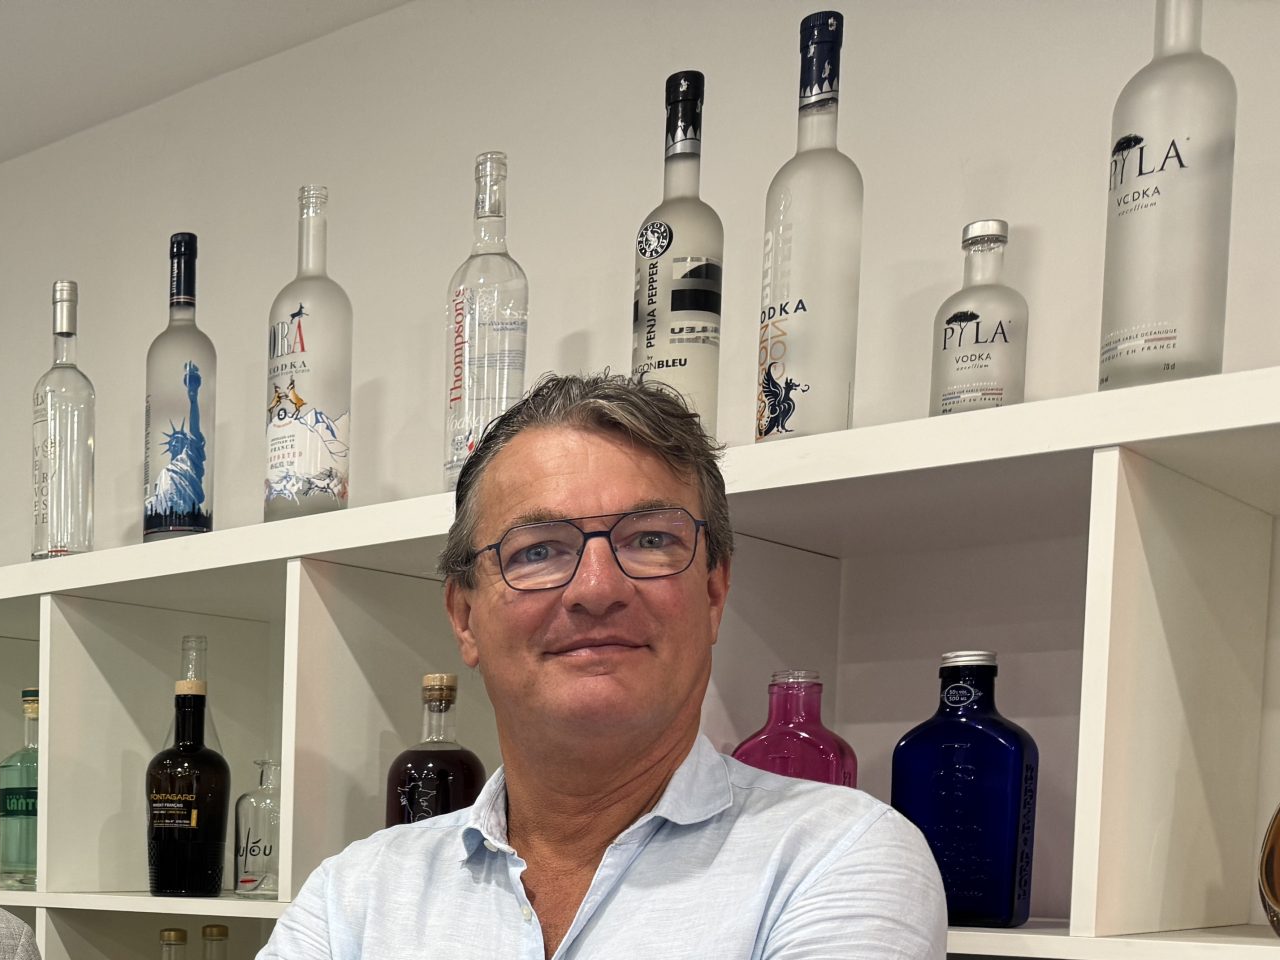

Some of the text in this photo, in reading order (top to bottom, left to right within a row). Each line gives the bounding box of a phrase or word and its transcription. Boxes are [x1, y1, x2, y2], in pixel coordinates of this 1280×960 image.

[646, 260, 659, 349] PENJA PEPPER
[760, 299, 808, 325] ODKA
[449, 288, 470, 409] Thompson's
[954, 352, 992, 364] VODKA
[1141, 343, 1177, 352] FRANCE
